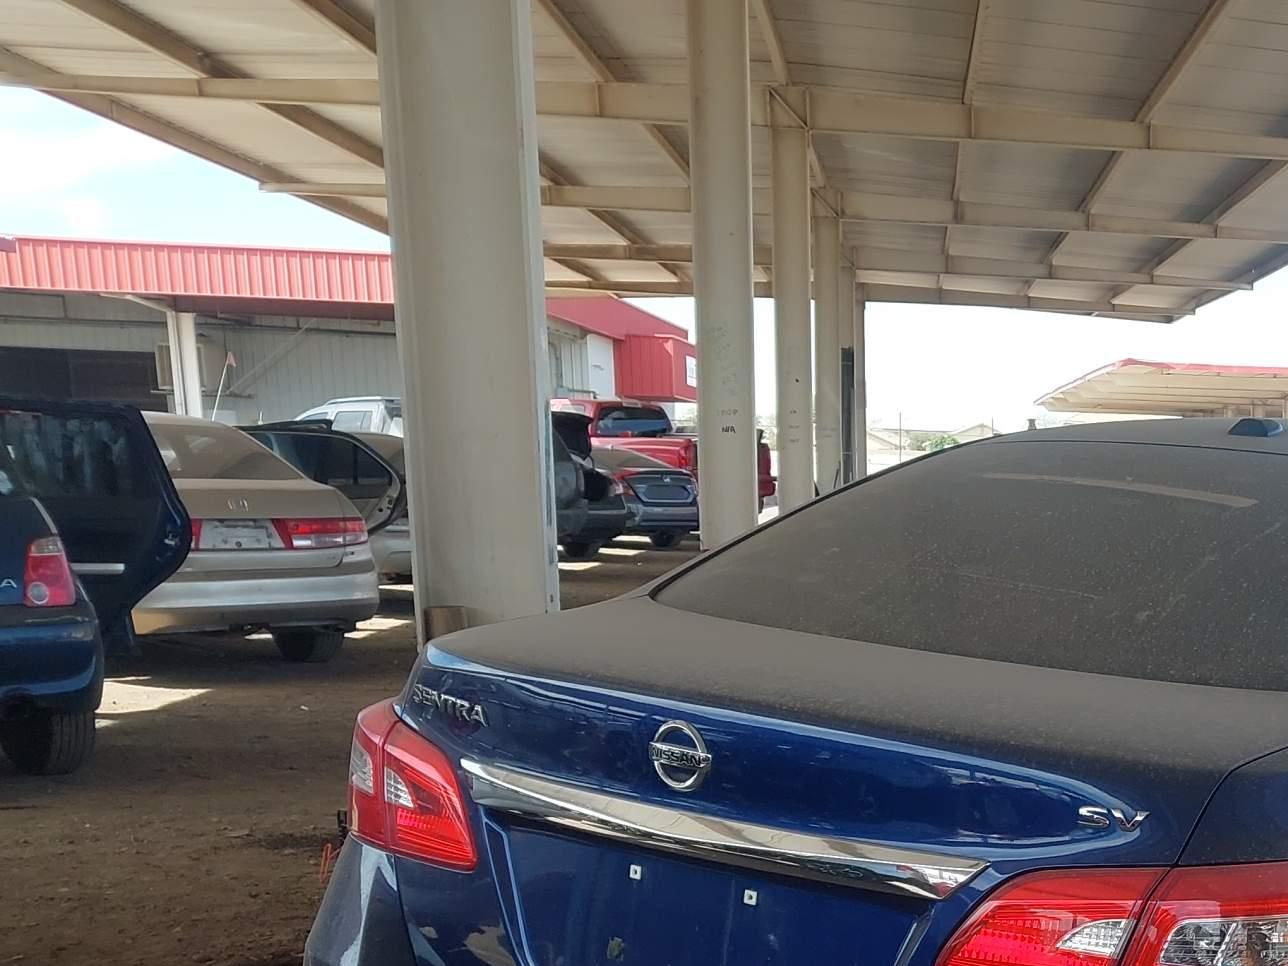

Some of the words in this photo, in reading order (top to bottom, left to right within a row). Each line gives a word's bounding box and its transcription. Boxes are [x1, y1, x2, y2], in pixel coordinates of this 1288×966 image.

[412, 683, 489, 727] SENTRA
[652, 743, 702, 767] NISSAN
[1077, 805, 1151, 832] SV
